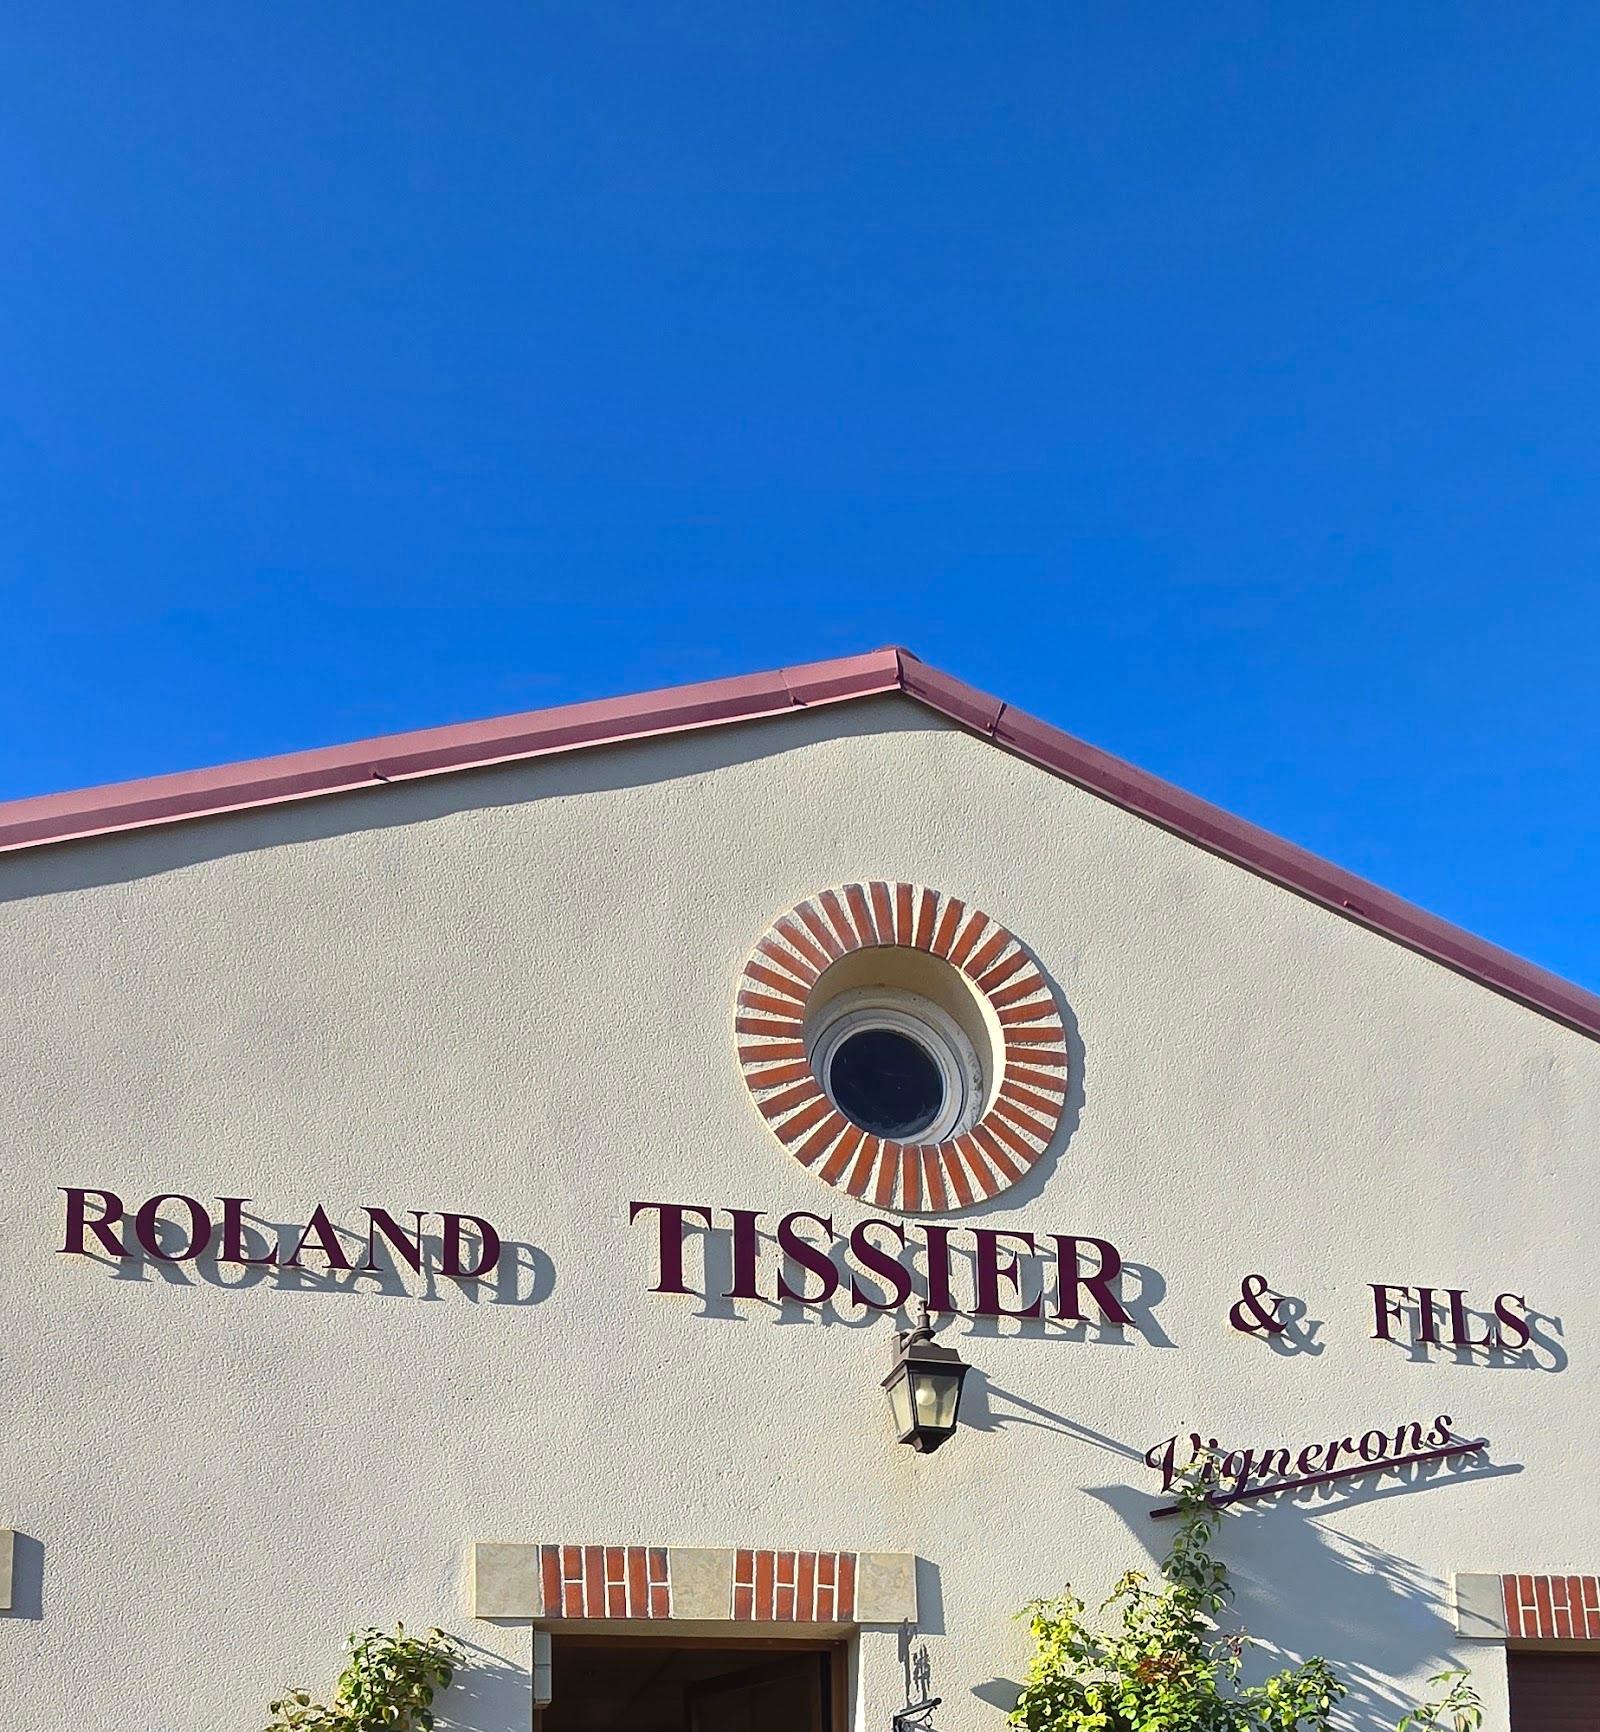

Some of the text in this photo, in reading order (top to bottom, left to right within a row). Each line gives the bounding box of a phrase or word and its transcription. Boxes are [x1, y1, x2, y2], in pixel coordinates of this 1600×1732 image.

[57, 1187, 1531, 1350] ROLAND TISSIER & FILS
[1145, 1414, 1453, 1509] Vignerons
